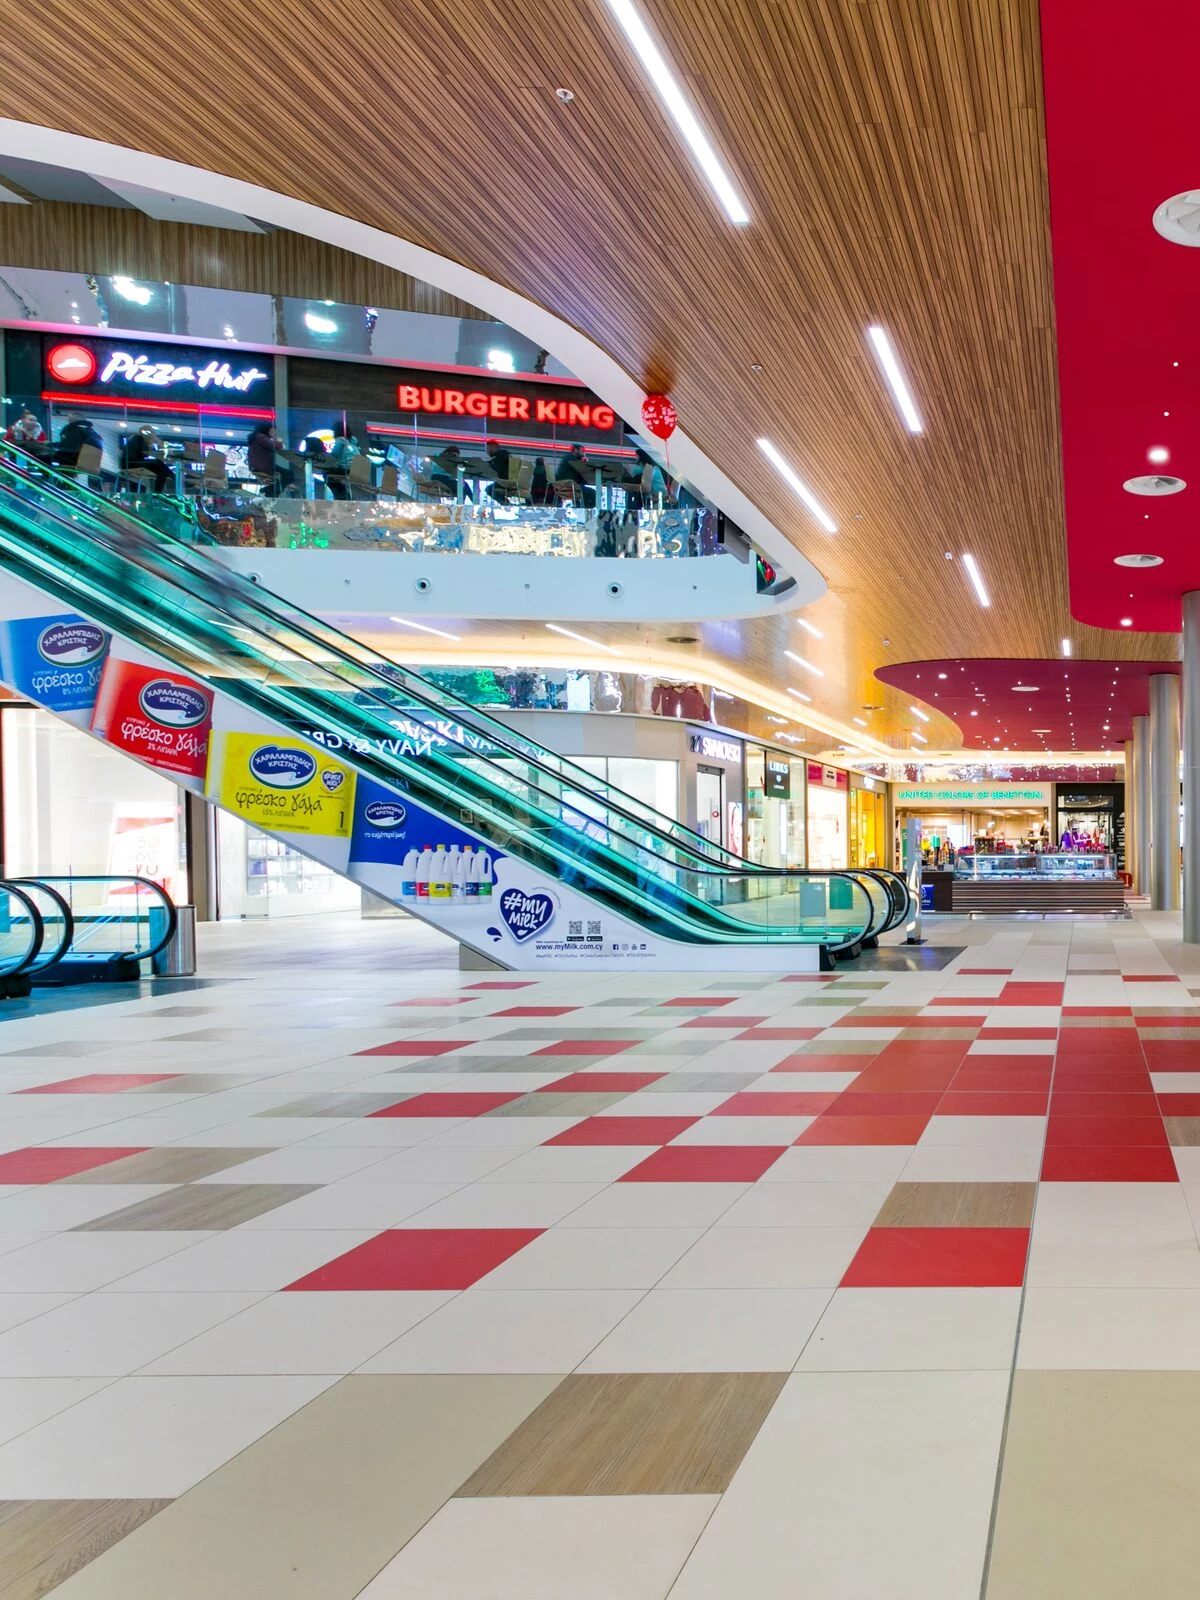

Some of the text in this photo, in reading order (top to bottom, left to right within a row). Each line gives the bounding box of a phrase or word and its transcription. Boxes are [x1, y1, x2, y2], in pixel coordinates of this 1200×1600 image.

[101, 352, 267, 391] Pizza Hut
[398, 385, 530, 420] BURGER
[536, 400, 615, 430] KING
[147, 688, 204, 711] ΧΑΡΑΛΑΜΠΙΔΗΣ
[160, 697, 190, 709] ΚΡΙΣΤΗΣ
[255, 754, 312, 769] ΧΑΡΑΛΑΜΠΙΔΗΣ
[268, 760, 298, 769] ΚΡΙΣΤΗΣ
[898, 791, 934, 799] UNITED
[937, 791, 974, 799] COLORS
[976, 791, 989, 799] OF
[339, 811, 345, 828] 1
[503, 892, 548, 922] #my
[535, 943, 603, 951] www.myMilk.com.cy
